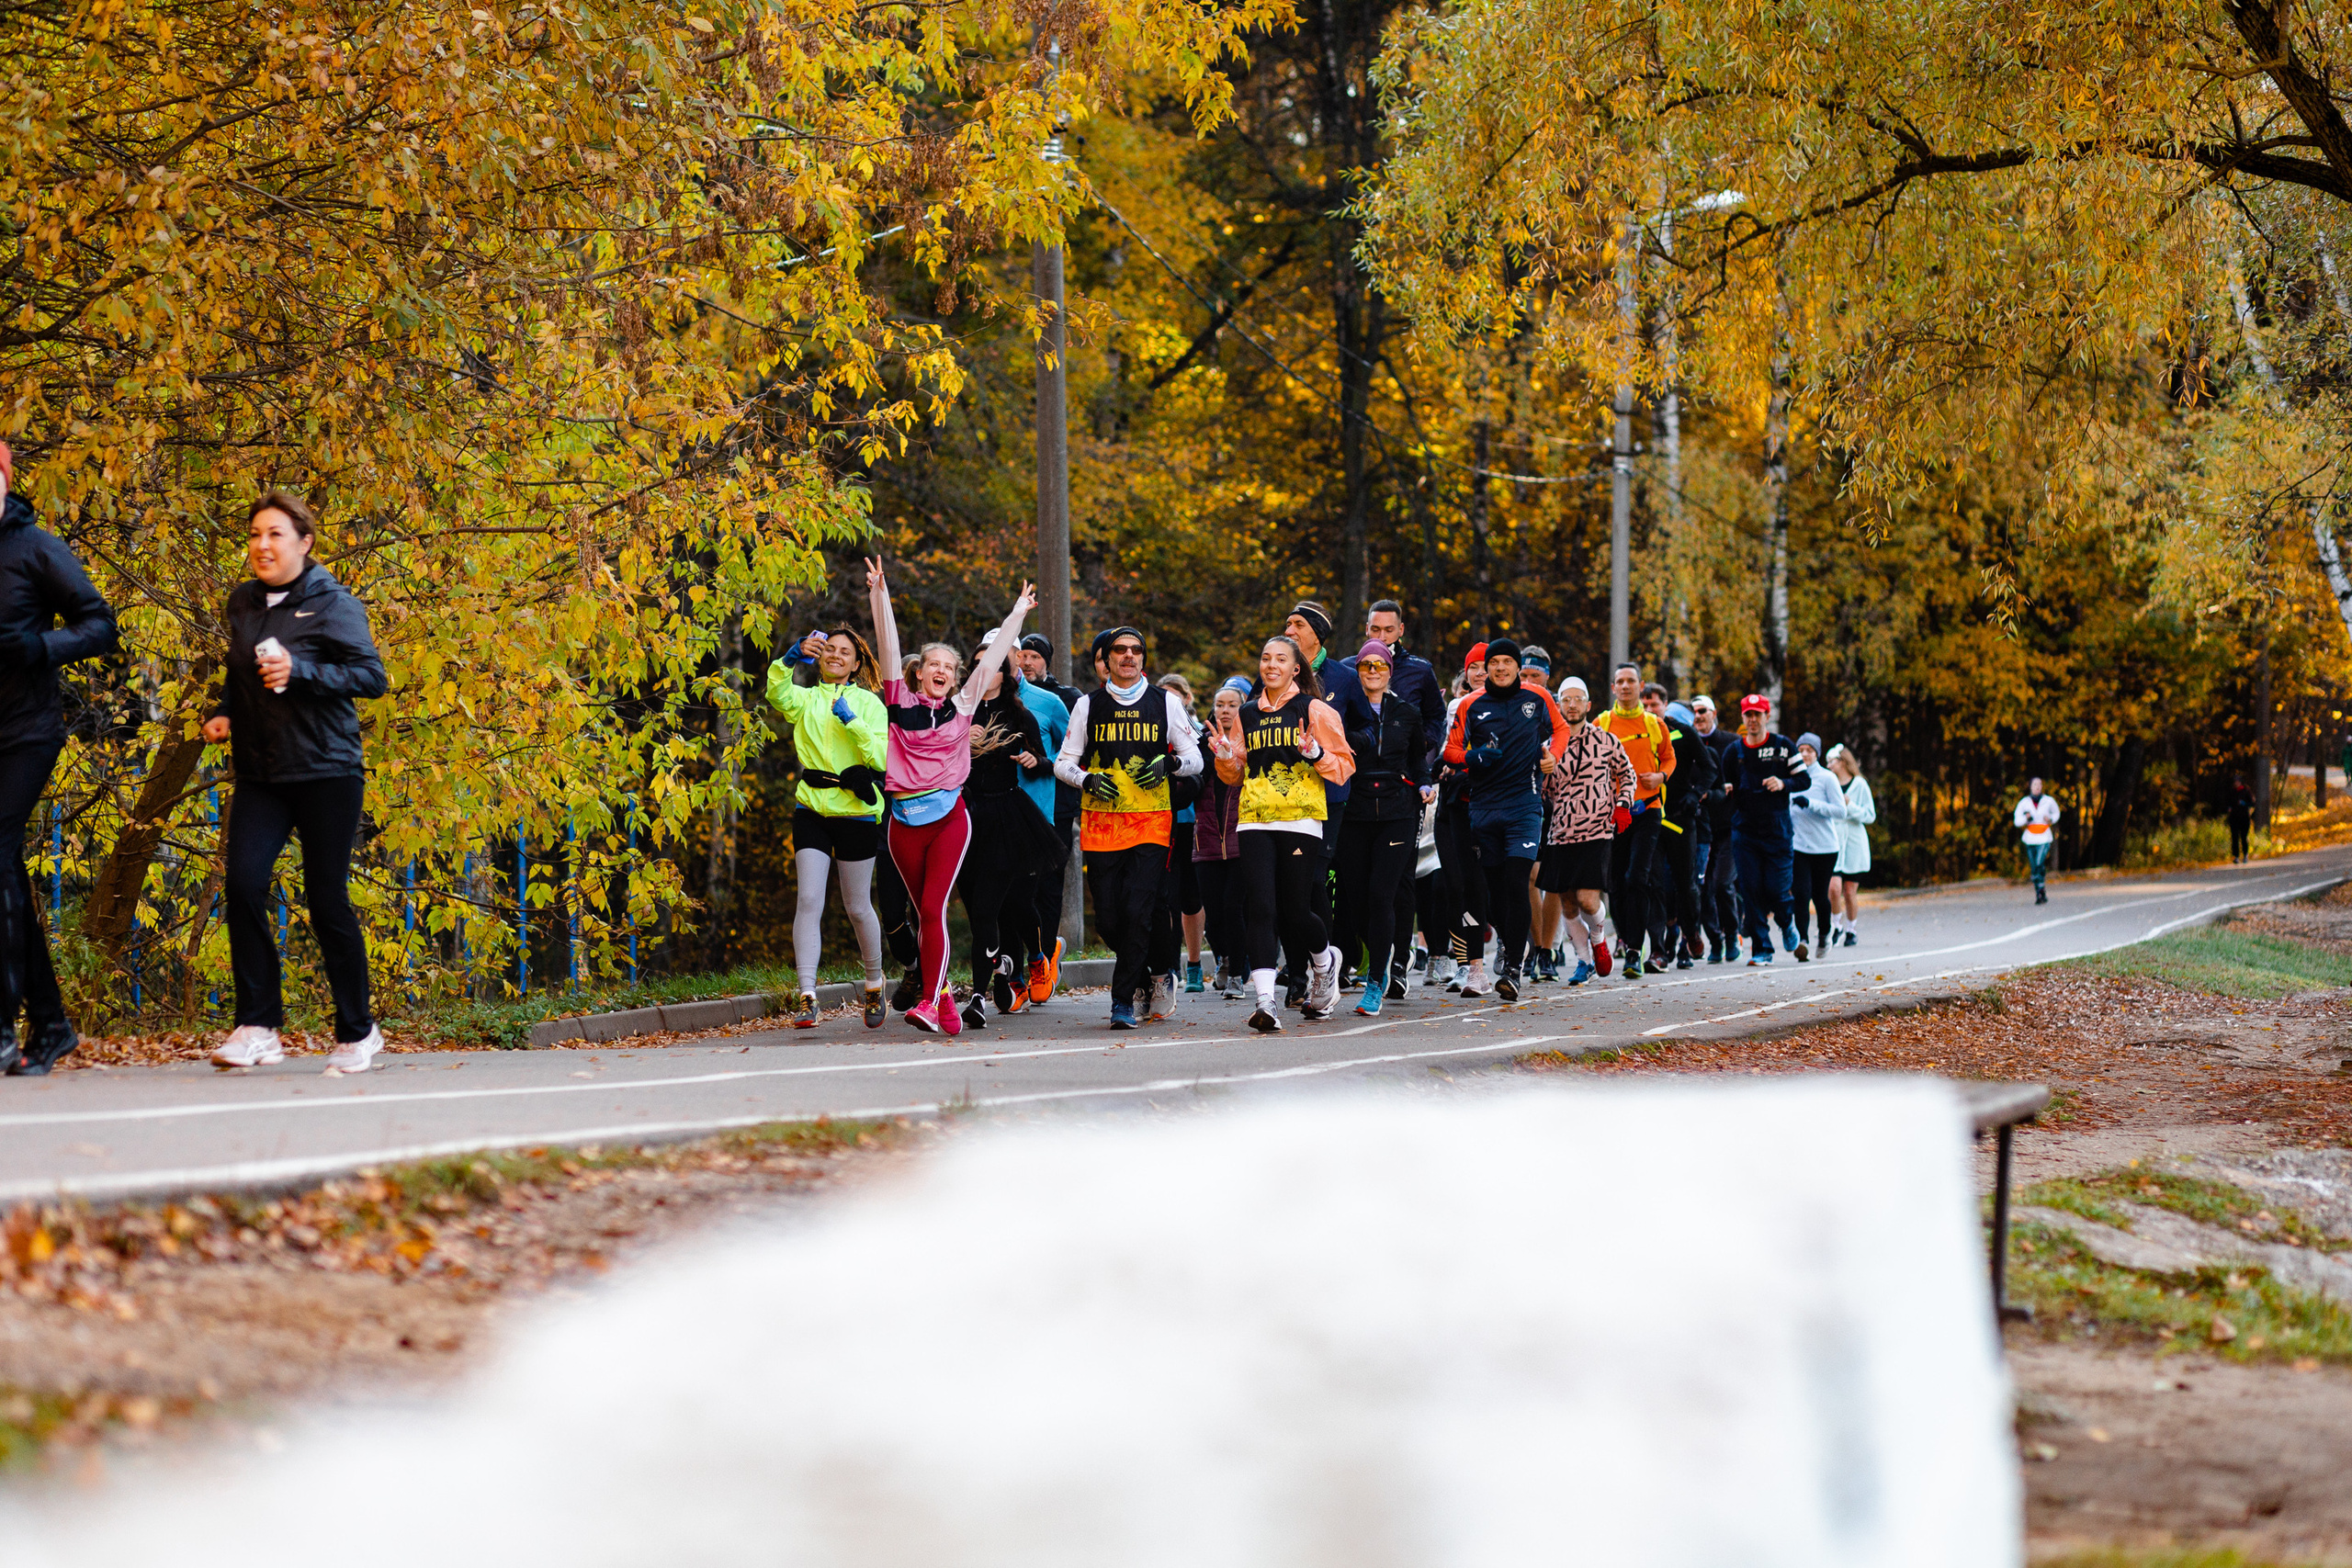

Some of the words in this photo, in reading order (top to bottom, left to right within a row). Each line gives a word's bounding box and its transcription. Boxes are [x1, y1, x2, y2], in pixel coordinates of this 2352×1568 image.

[1114, 710, 1126, 718] PACE
[1127, 710, 1139, 718] 6:30
[1270, 716, 1283, 724] 6:30
[1094, 722, 1159, 742] IZMYLONG
